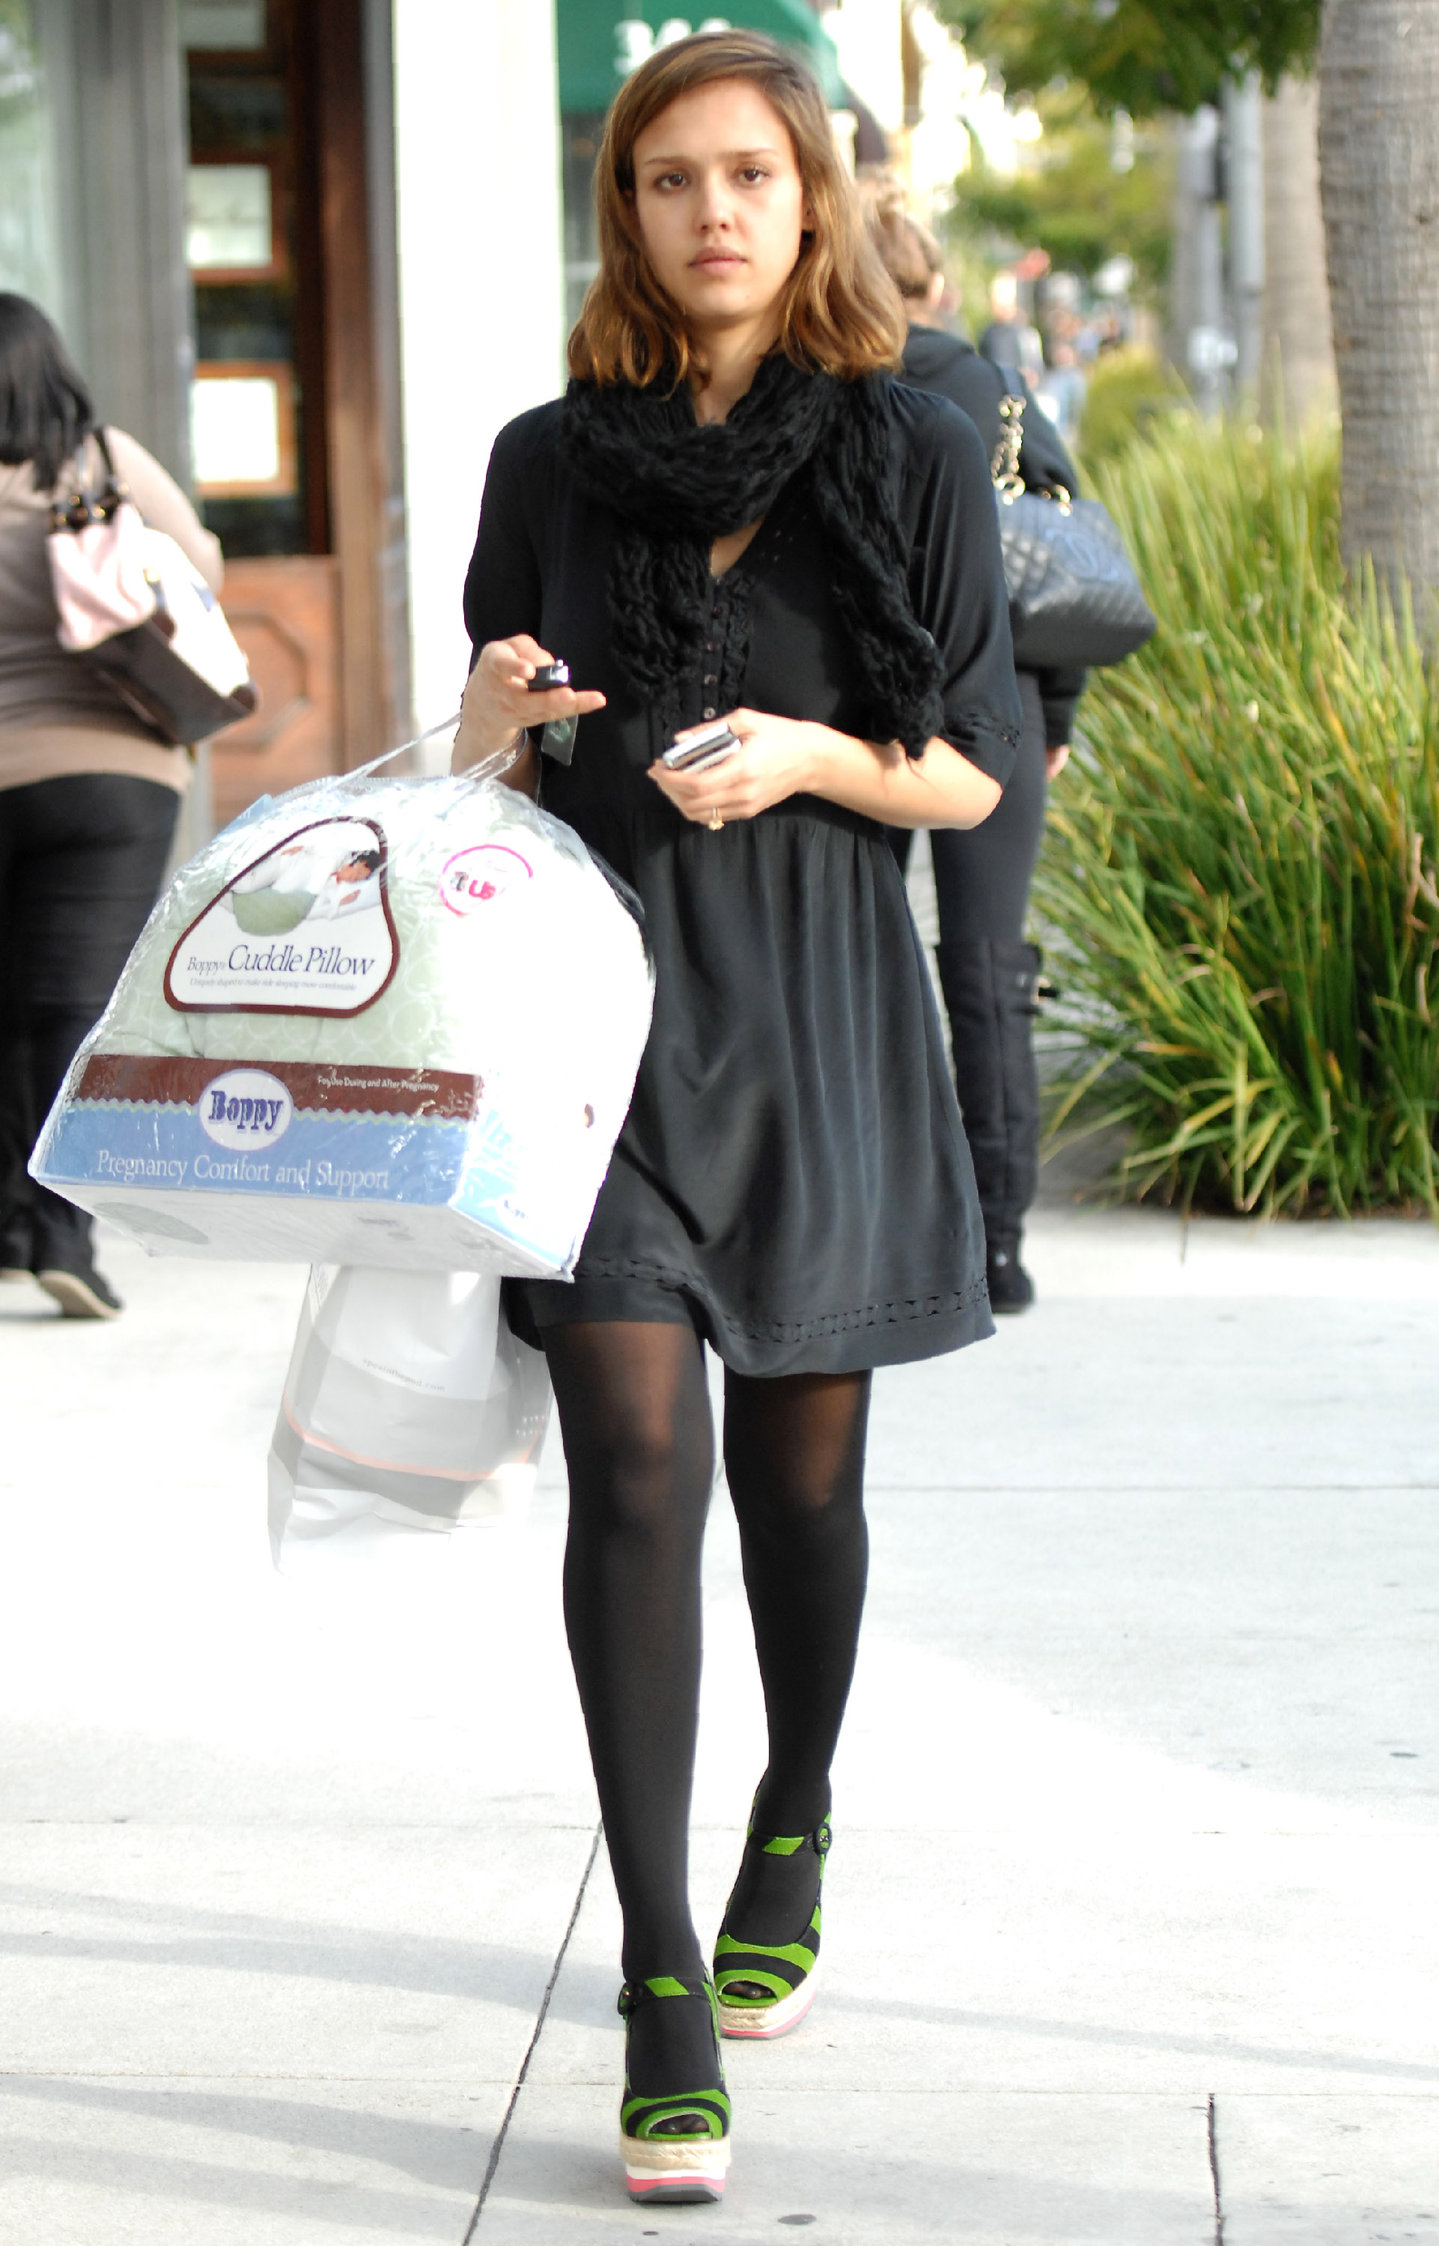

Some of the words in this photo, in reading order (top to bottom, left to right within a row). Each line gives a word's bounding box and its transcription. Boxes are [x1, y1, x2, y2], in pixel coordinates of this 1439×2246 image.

[228, 944, 302, 973] Cuddle
[303, 946, 376, 976] Pillow
[344, 1076, 366, 1089] During
[367, 1078, 380, 1087] and
[381, 1078, 399, 1088] After
[401, 1078, 439, 1093] Pregnancy
[208, 1090, 284, 1131] Boppy
[97, 1149, 188, 1184] Pregnancy
[193, 1153, 270, 1182] Comfort
[275, 1159, 310, 1185] and
[315, 1160, 389, 1196] Support
